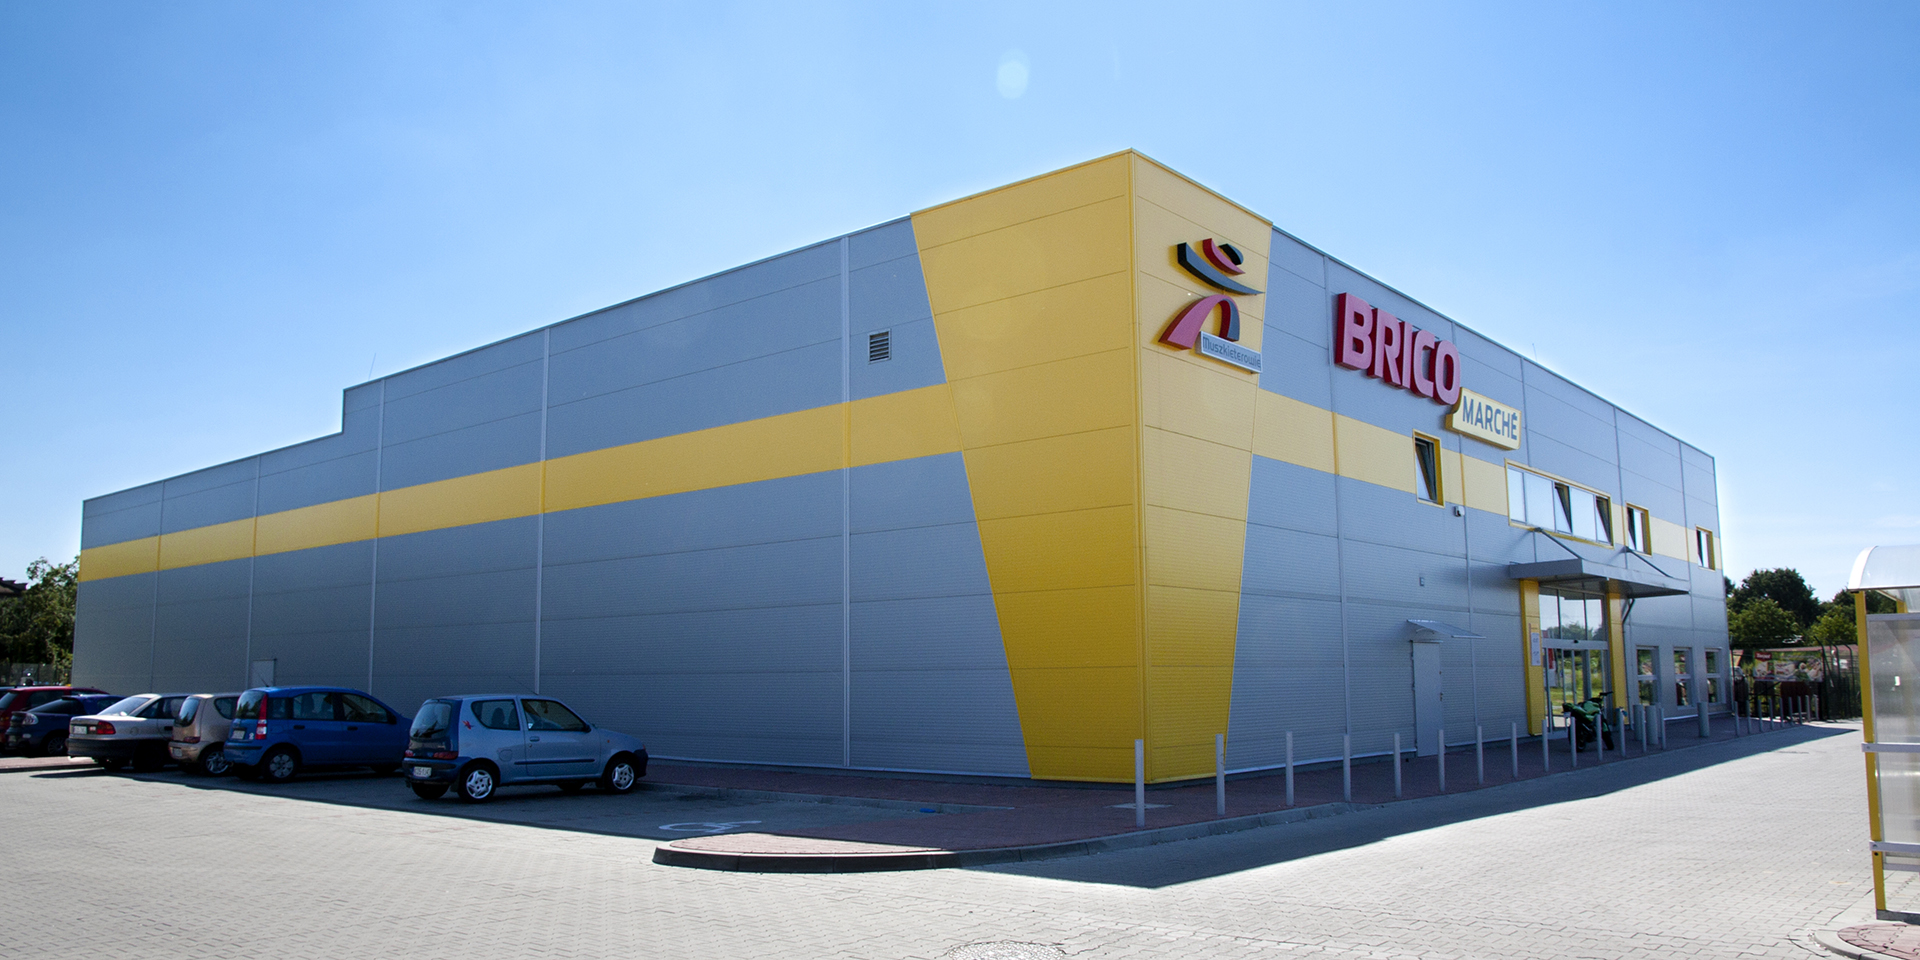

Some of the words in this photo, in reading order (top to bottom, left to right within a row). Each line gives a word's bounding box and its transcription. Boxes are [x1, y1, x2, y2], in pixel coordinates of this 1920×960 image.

[1202, 336, 1261, 368] Muszkieterowie
[1335, 292, 1461, 405] BRICO
[1462, 396, 1518, 441] MARCHÉ
